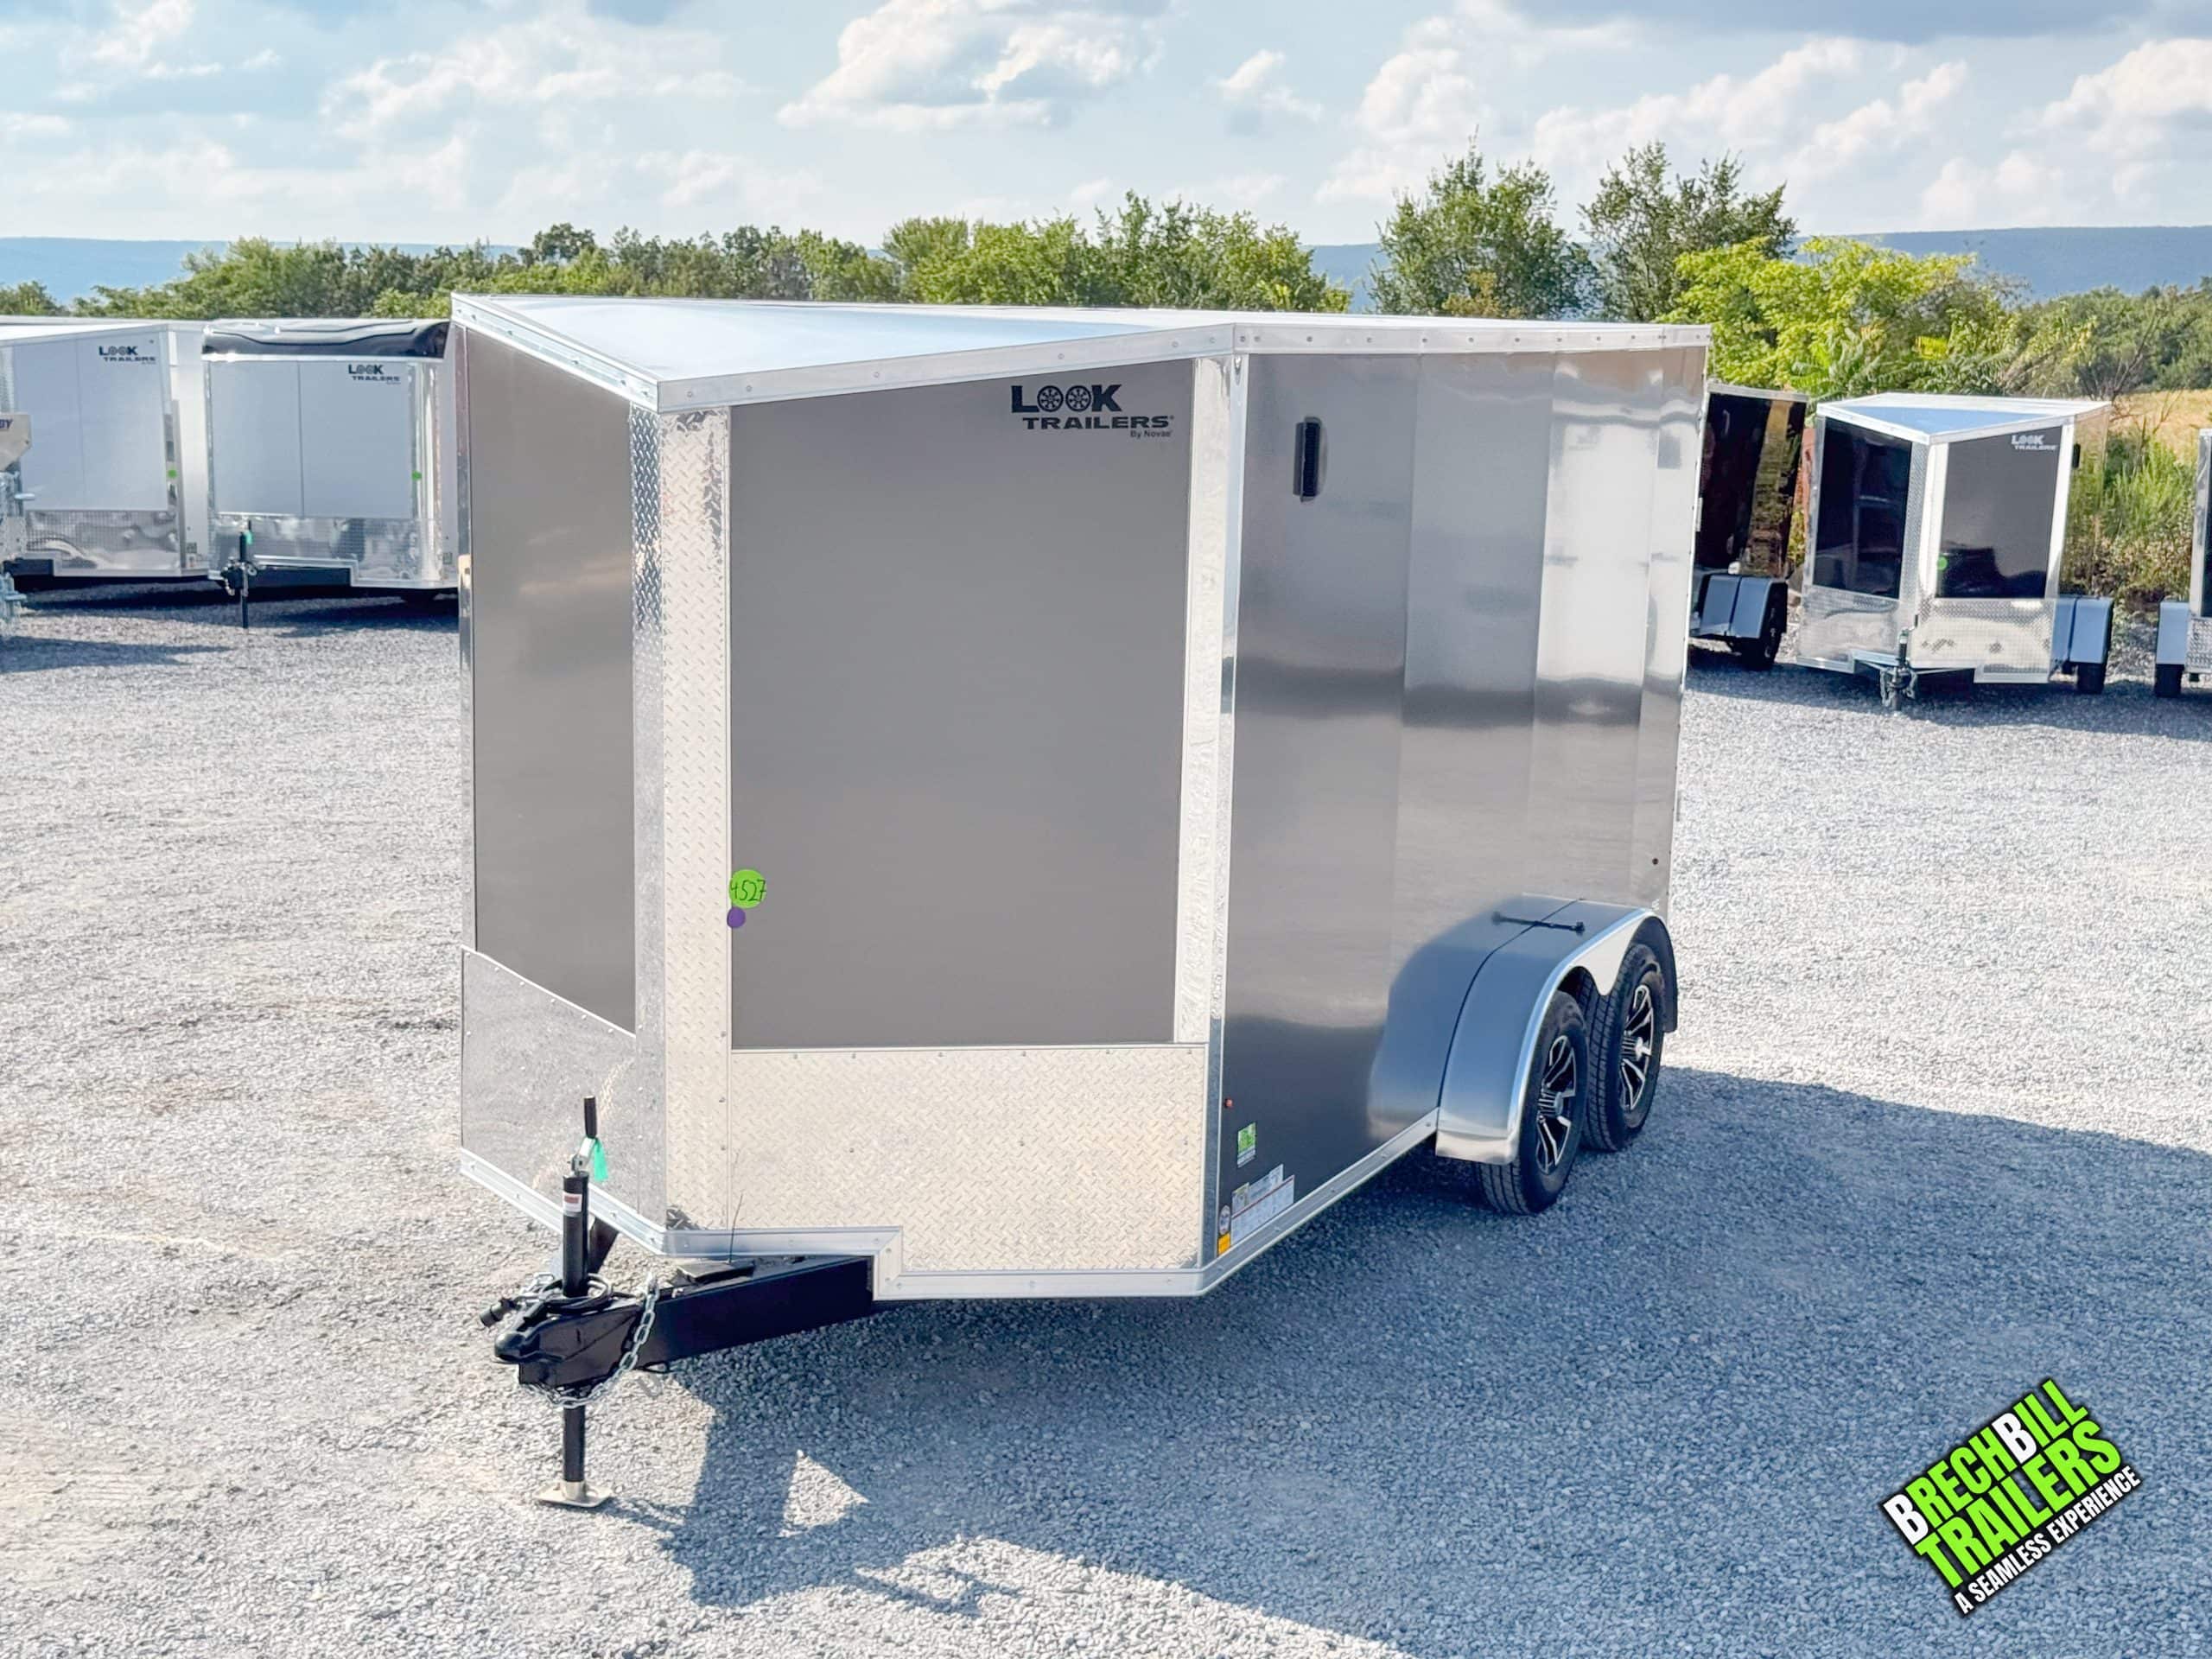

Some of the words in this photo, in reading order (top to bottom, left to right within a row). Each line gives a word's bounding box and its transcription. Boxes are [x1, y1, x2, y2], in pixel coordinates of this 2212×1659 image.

[99, 346, 138, 356] LOOK
[348, 364, 384, 374] LOOK
[1011, 384, 1122, 413] LOOK
[1022, 416, 1169, 429] TRAILERS
[2012, 435, 2045, 445] LOOK
